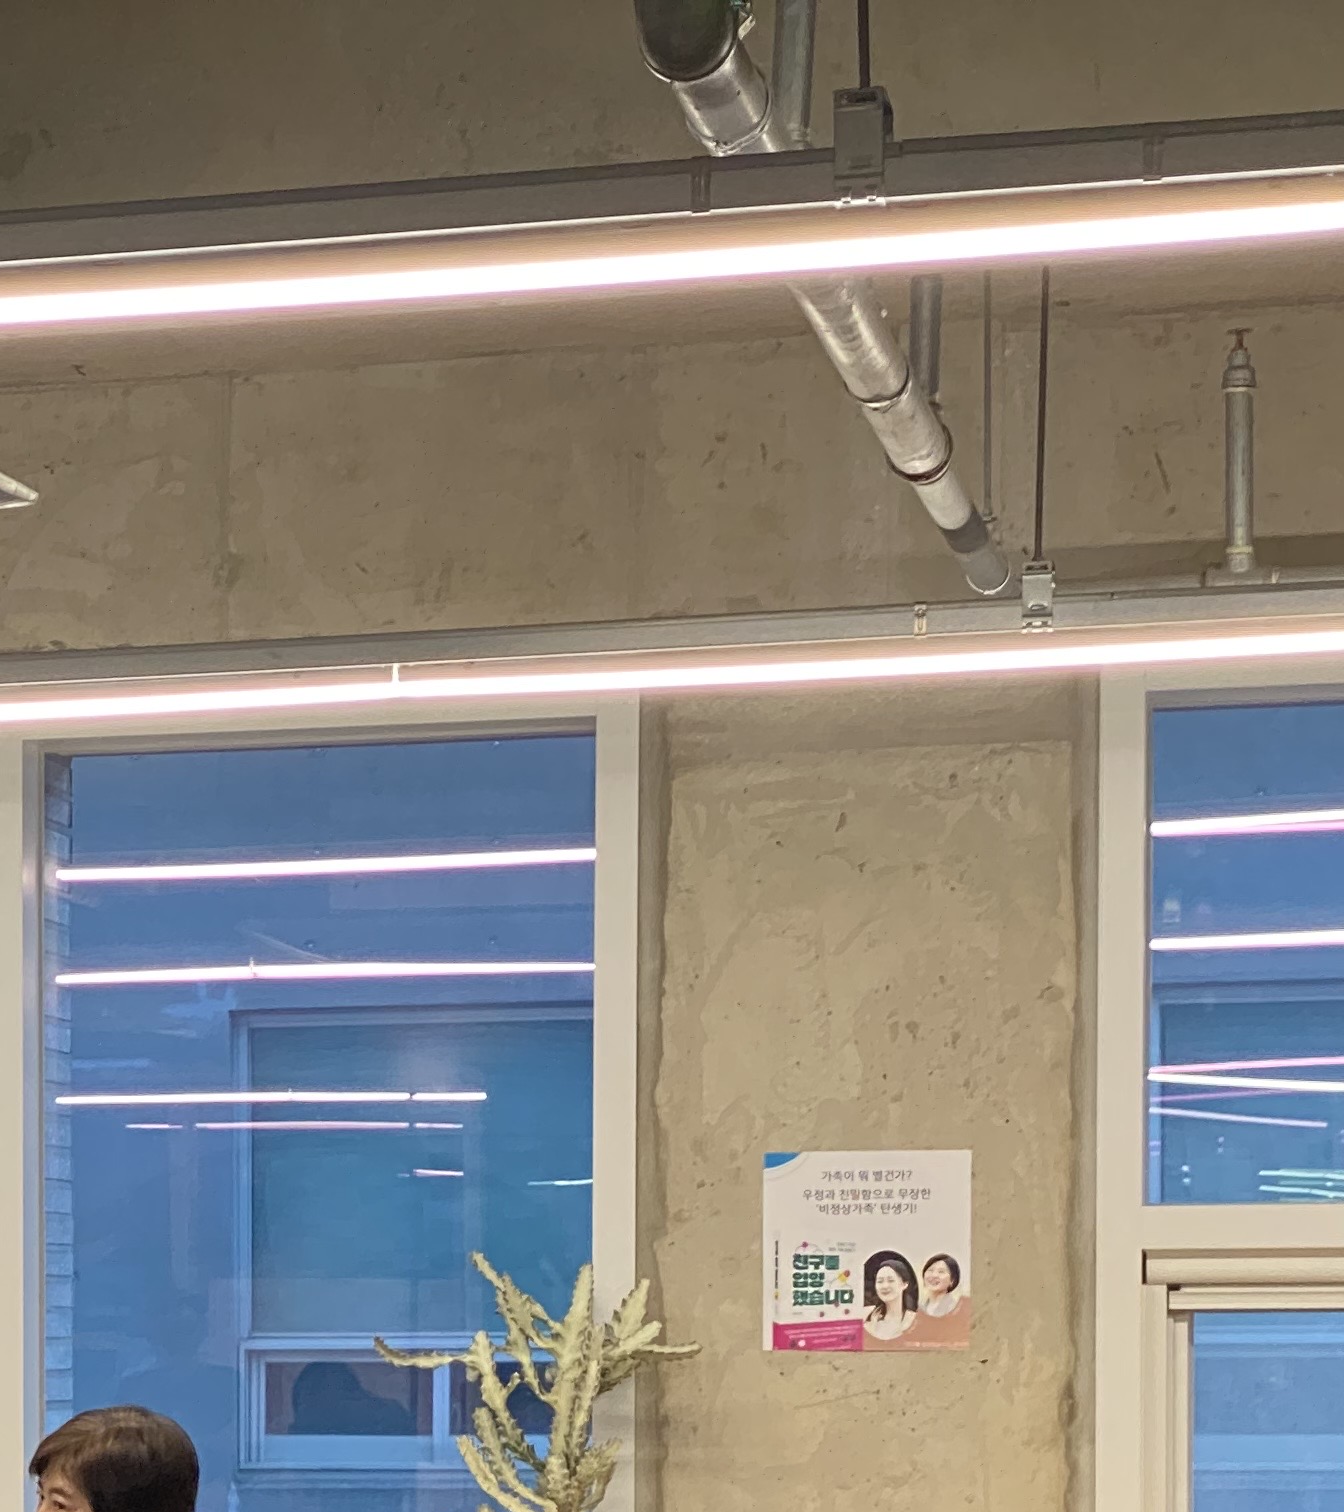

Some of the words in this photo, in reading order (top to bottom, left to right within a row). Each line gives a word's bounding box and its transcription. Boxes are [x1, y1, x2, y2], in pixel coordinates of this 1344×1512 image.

[821, 1170, 855, 1182] 가족이
[872, 1170, 913, 1182] 별건가?
[802, 1189, 835, 1201] 우정과
[839, 1188, 894, 1200] 친밀함으로
[792, 1272, 825, 1289] 입양
